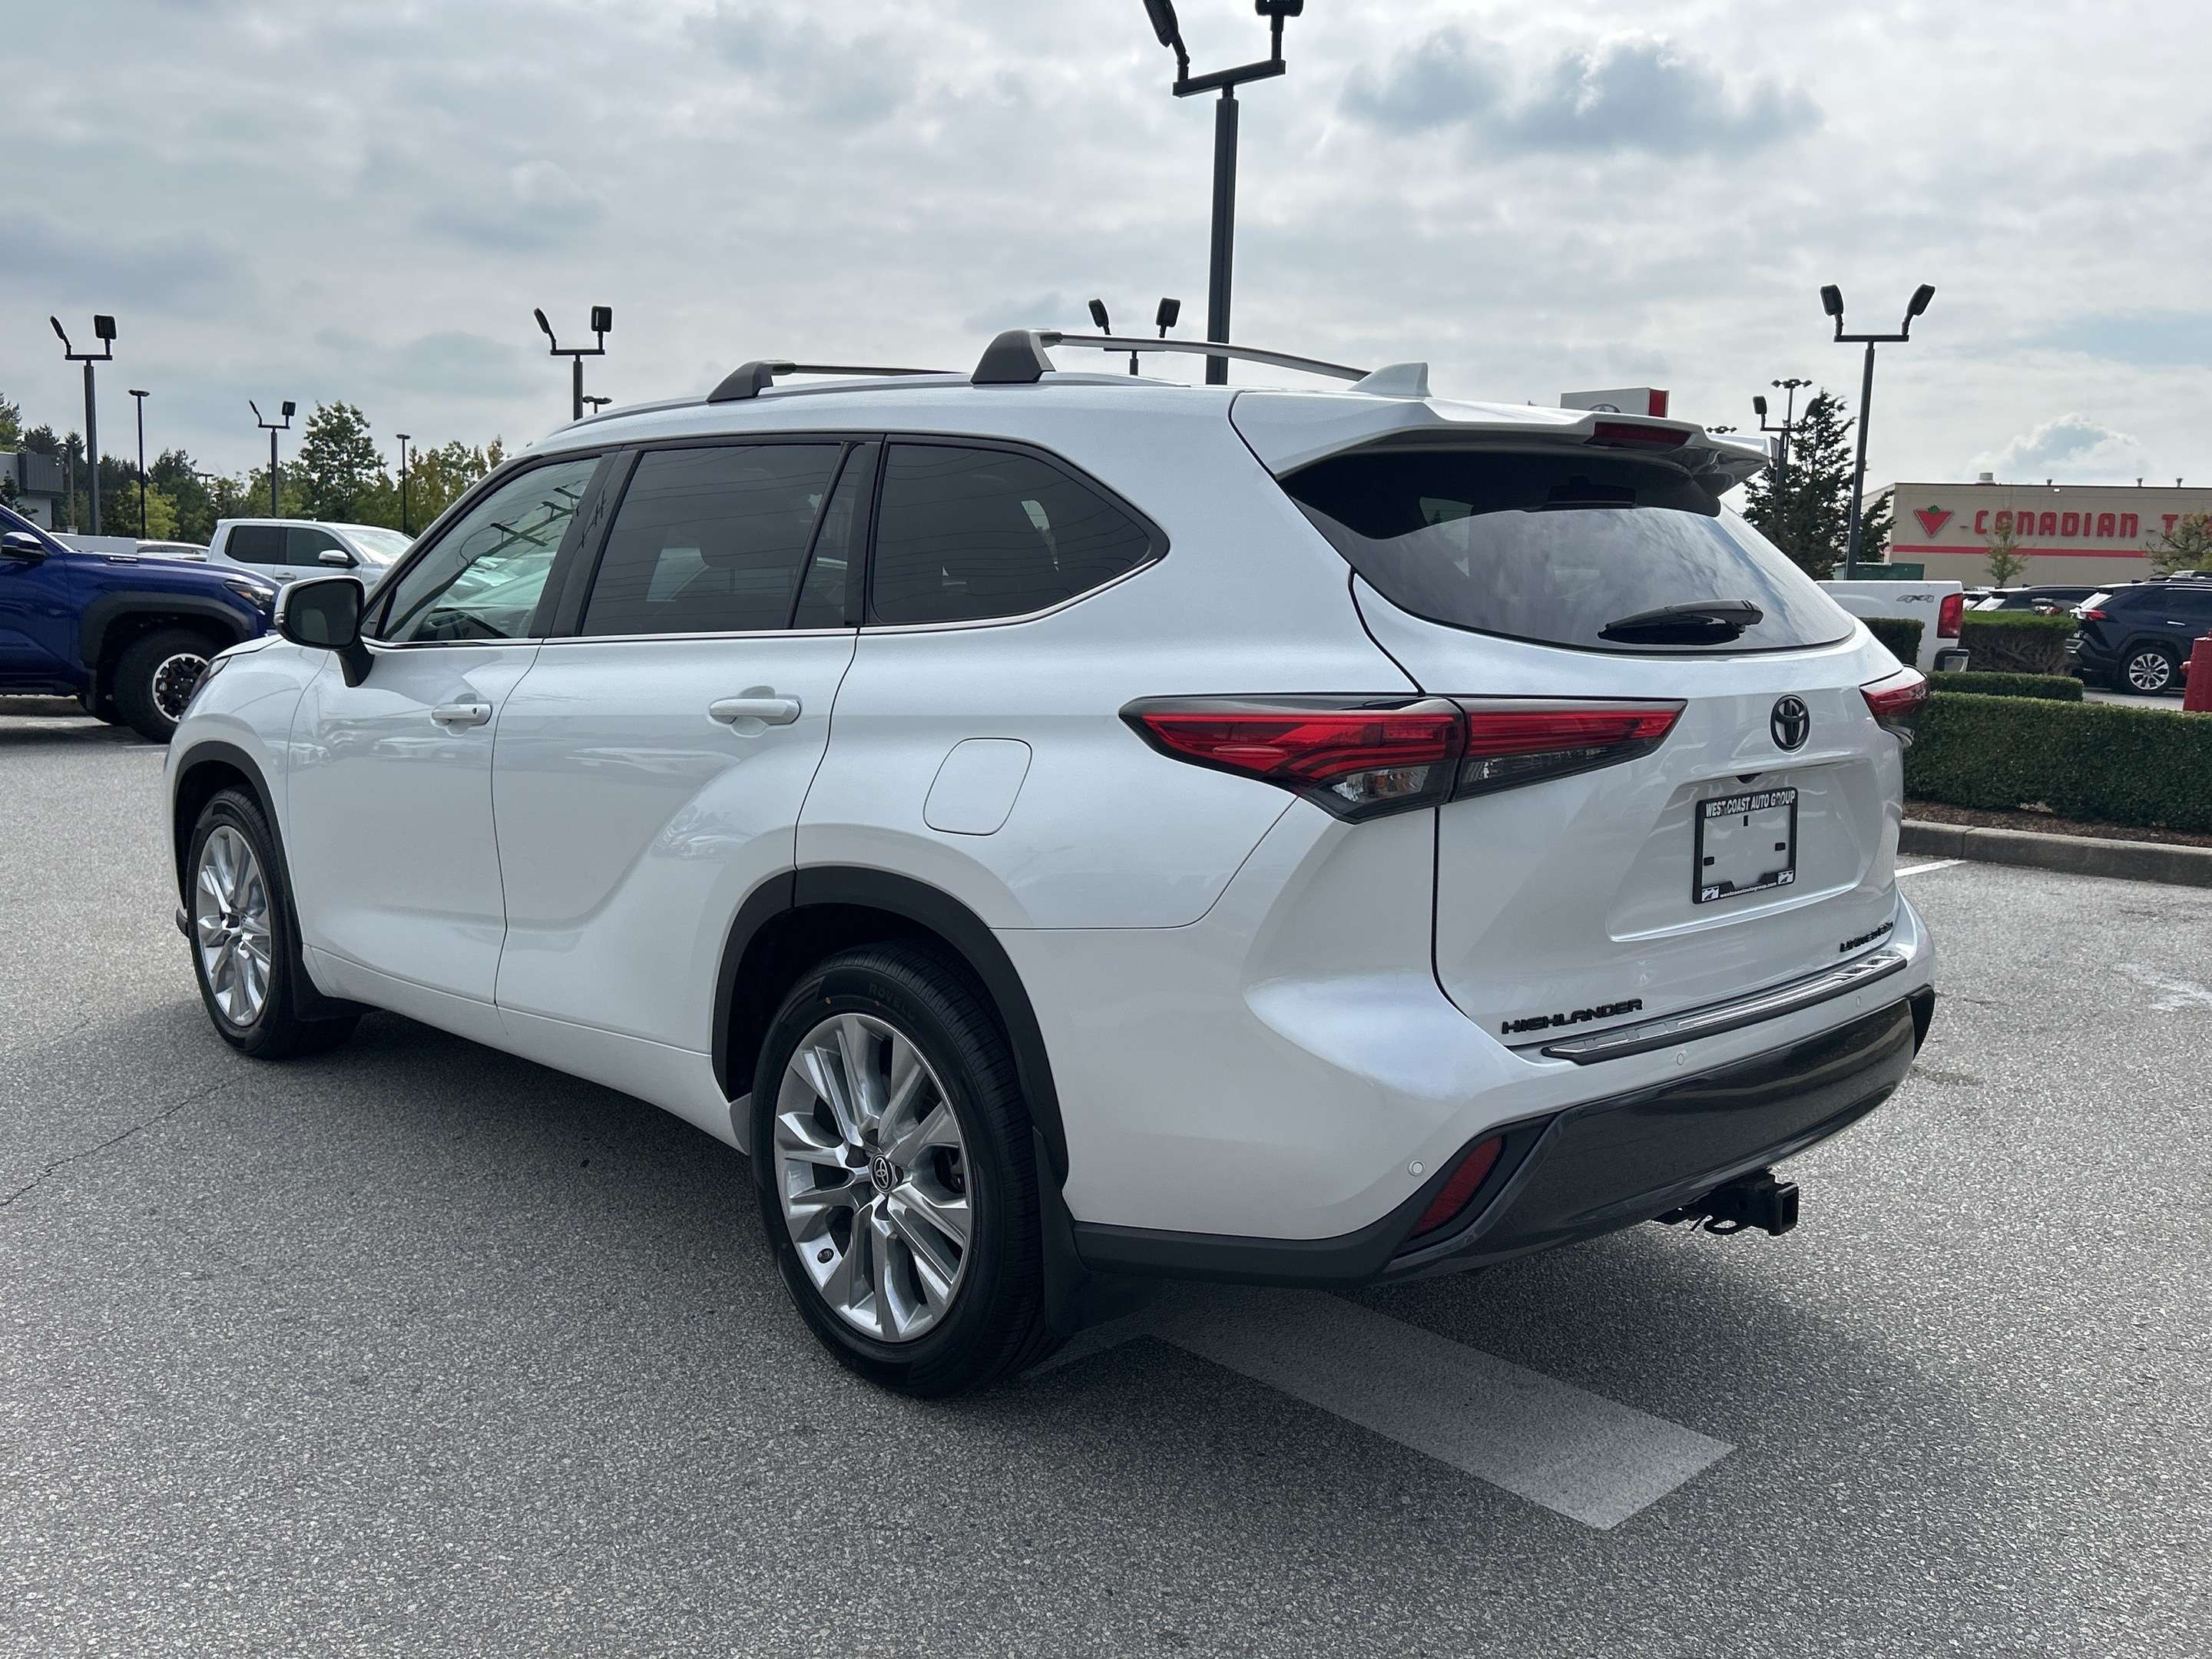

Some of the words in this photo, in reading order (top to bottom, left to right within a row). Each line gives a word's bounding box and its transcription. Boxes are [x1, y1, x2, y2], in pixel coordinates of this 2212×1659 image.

[1974, 510, 2138, 538] CANADIAN
[1727, 796, 1750, 814] COAST
[1750, 793, 1770, 810] AUTO
[1502, 998, 1643, 1035] HIGHLANDER
